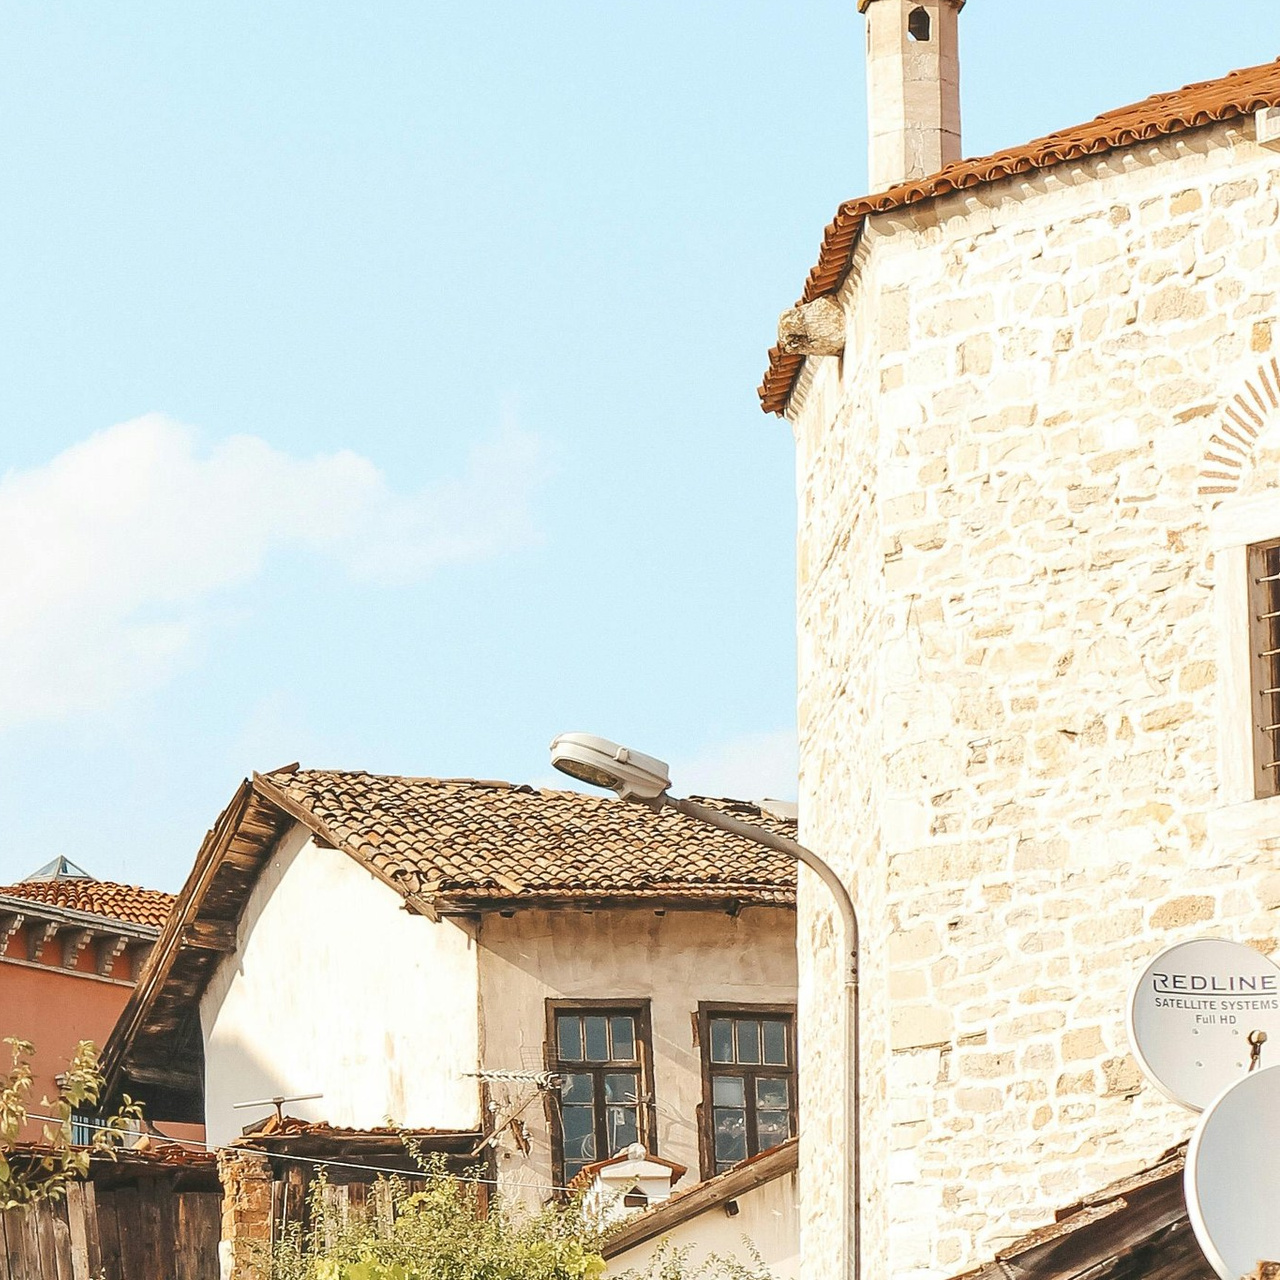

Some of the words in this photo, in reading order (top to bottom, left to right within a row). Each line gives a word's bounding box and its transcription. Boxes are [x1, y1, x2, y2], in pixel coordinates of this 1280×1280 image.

[1153, 973, 1278, 993] REDLINE
[1155, 997, 1216, 1010] SATELLITE
[1221, 999, 1279, 1011] SYSTEMS
[1195, 1014, 1216, 1024] Full
[1220, 1015, 1237, 1025] HD
